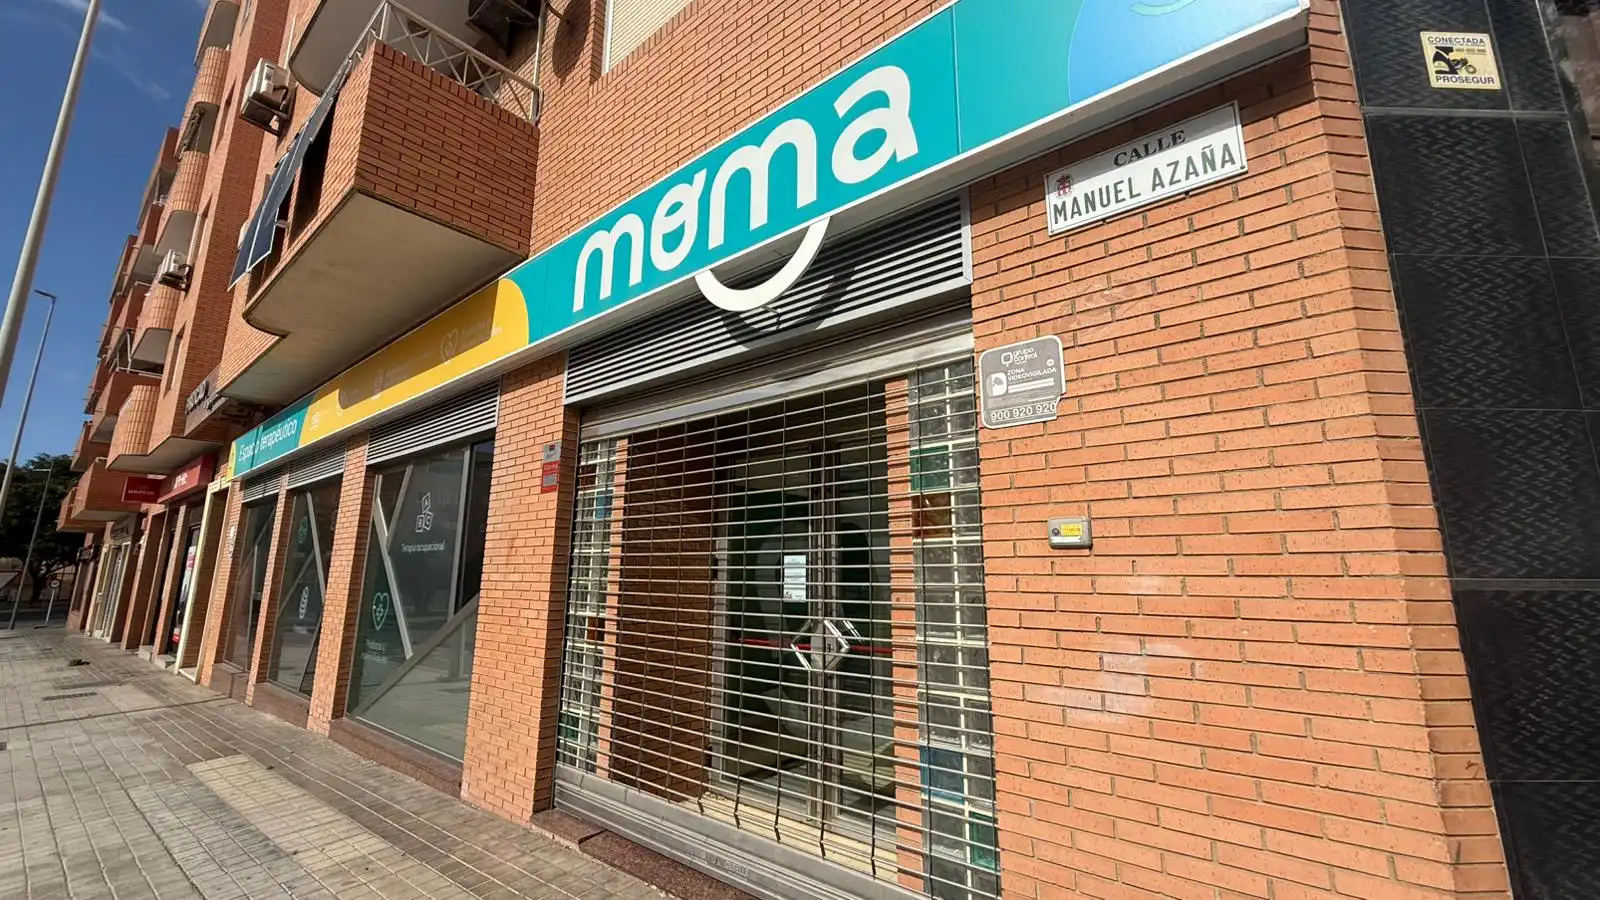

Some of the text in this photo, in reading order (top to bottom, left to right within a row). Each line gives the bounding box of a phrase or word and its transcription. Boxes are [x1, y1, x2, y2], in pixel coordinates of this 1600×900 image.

[1427, 36, 1485, 45] CONECTADA
[1435, 75, 1495, 85] PROSEGUR
[1113, 129, 1186, 167] CALLE
[1053, 143, 1236, 225] MANUEL AZAÑA
[1007, 367, 1025, 376] ZONA
[1007, 367, 1057, 381] VIDEOVIGILADA
[990, 402, 1057, 421] 900 920 920
